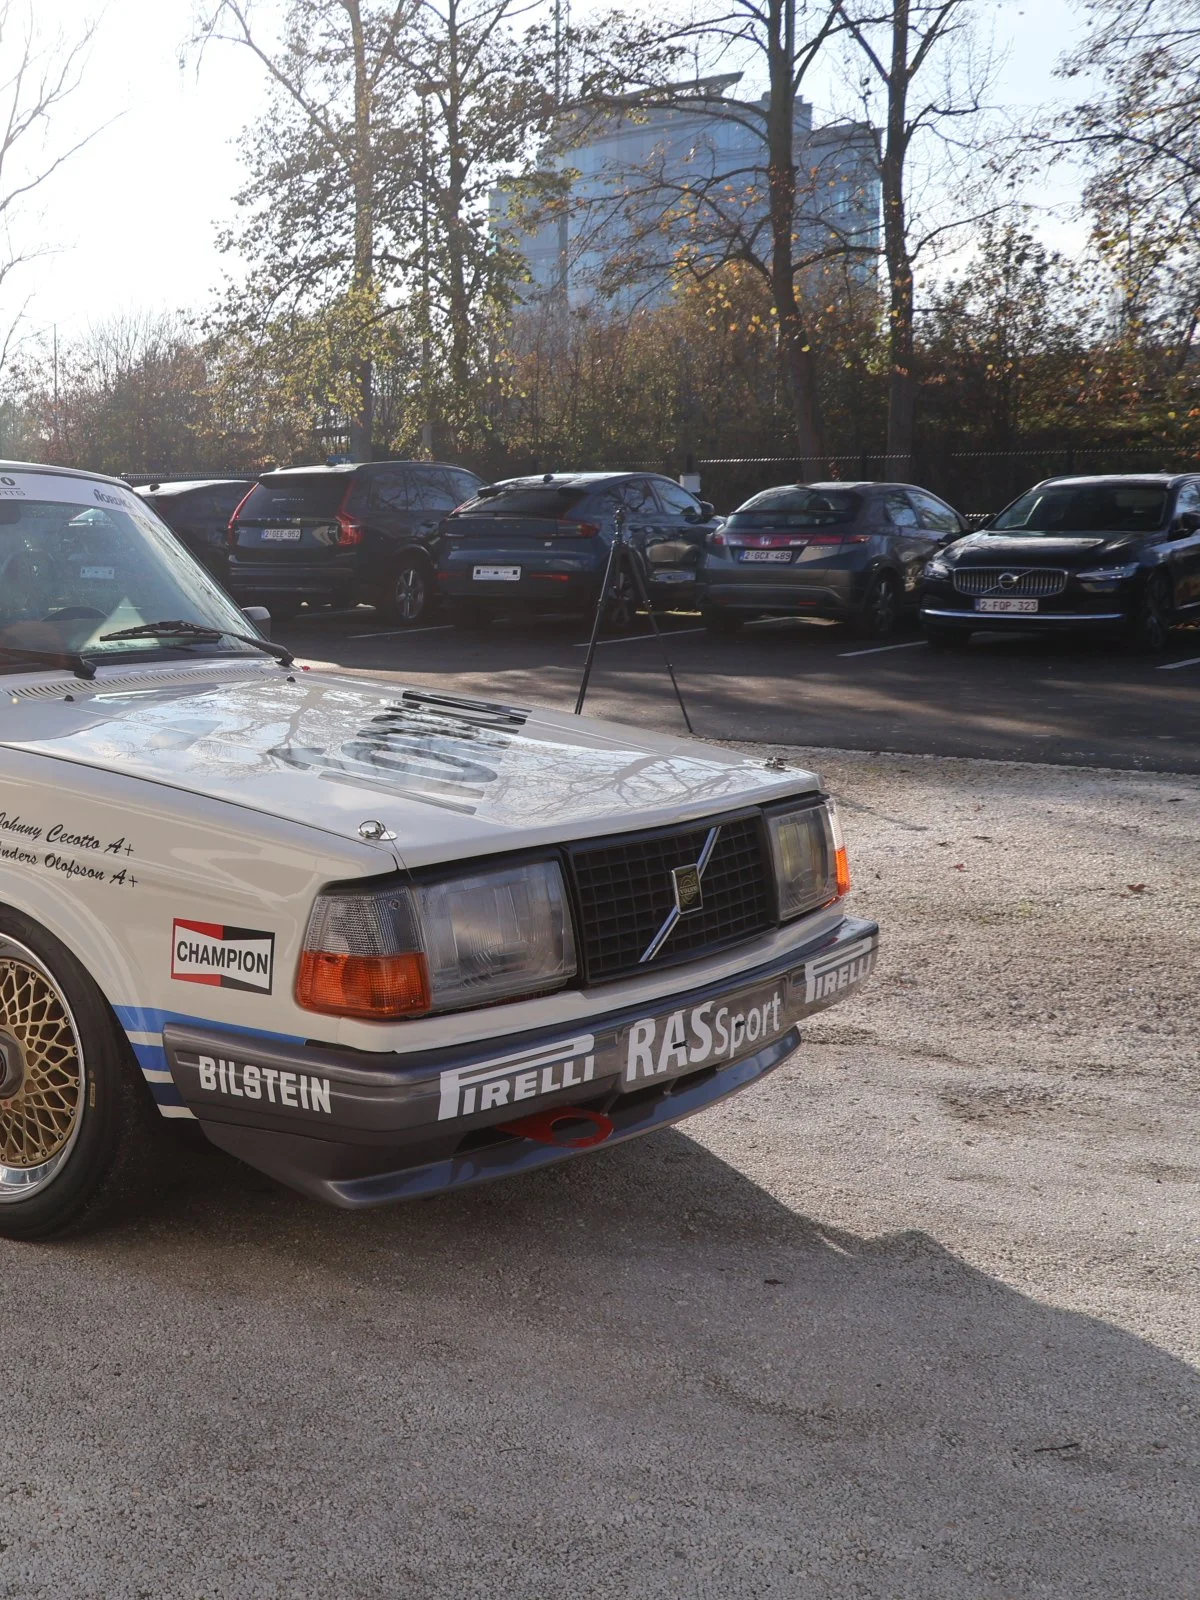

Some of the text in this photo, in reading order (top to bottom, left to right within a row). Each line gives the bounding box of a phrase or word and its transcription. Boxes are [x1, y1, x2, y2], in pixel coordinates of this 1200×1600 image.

[46, 824, 100, 850] Cecotto
[44, 853, 105, 881] Olofsson
[176, 940, 269, 974] CHAMPION
[805, 936, 872, 1004] PIRELLI
[199, 1056, 332, 1114] BILSTEIN
[438, 1034, 595, 1121] PIRELLI
